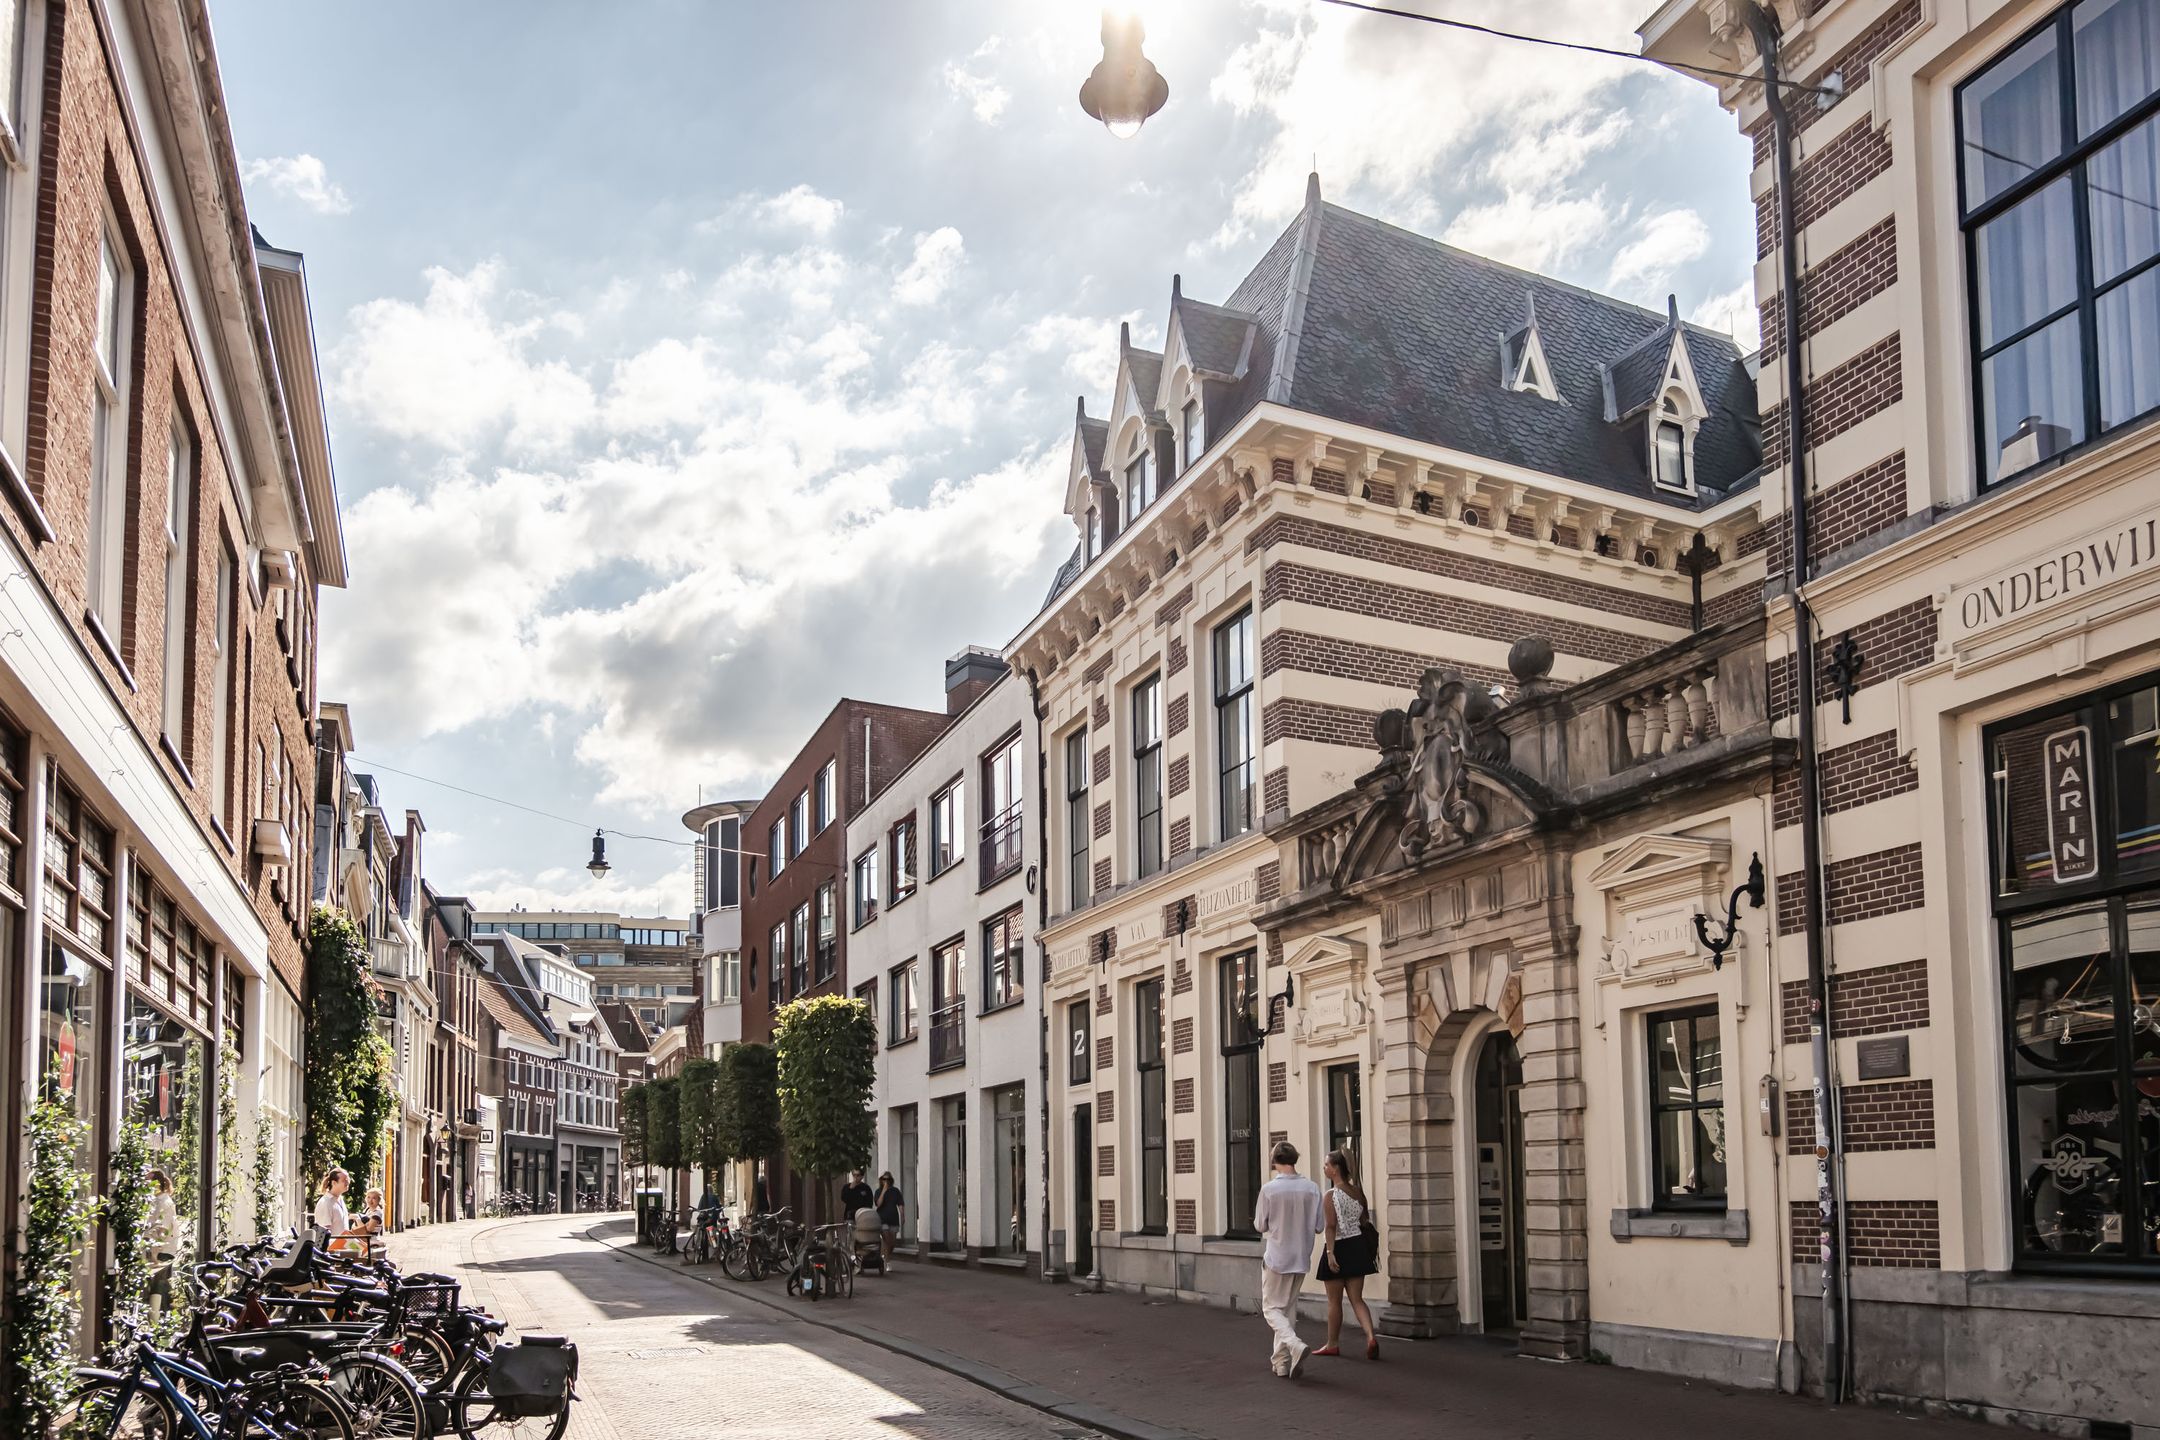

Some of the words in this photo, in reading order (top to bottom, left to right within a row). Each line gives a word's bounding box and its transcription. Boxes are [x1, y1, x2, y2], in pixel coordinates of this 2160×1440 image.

[1962, 519, 2156, 629] ONDERWIJ
[2054, 738, 2085, 861] MARIN
[1199, 879, 1251, 917] BIJZONDER
[1074, 1029, 1085, 1057] 2
